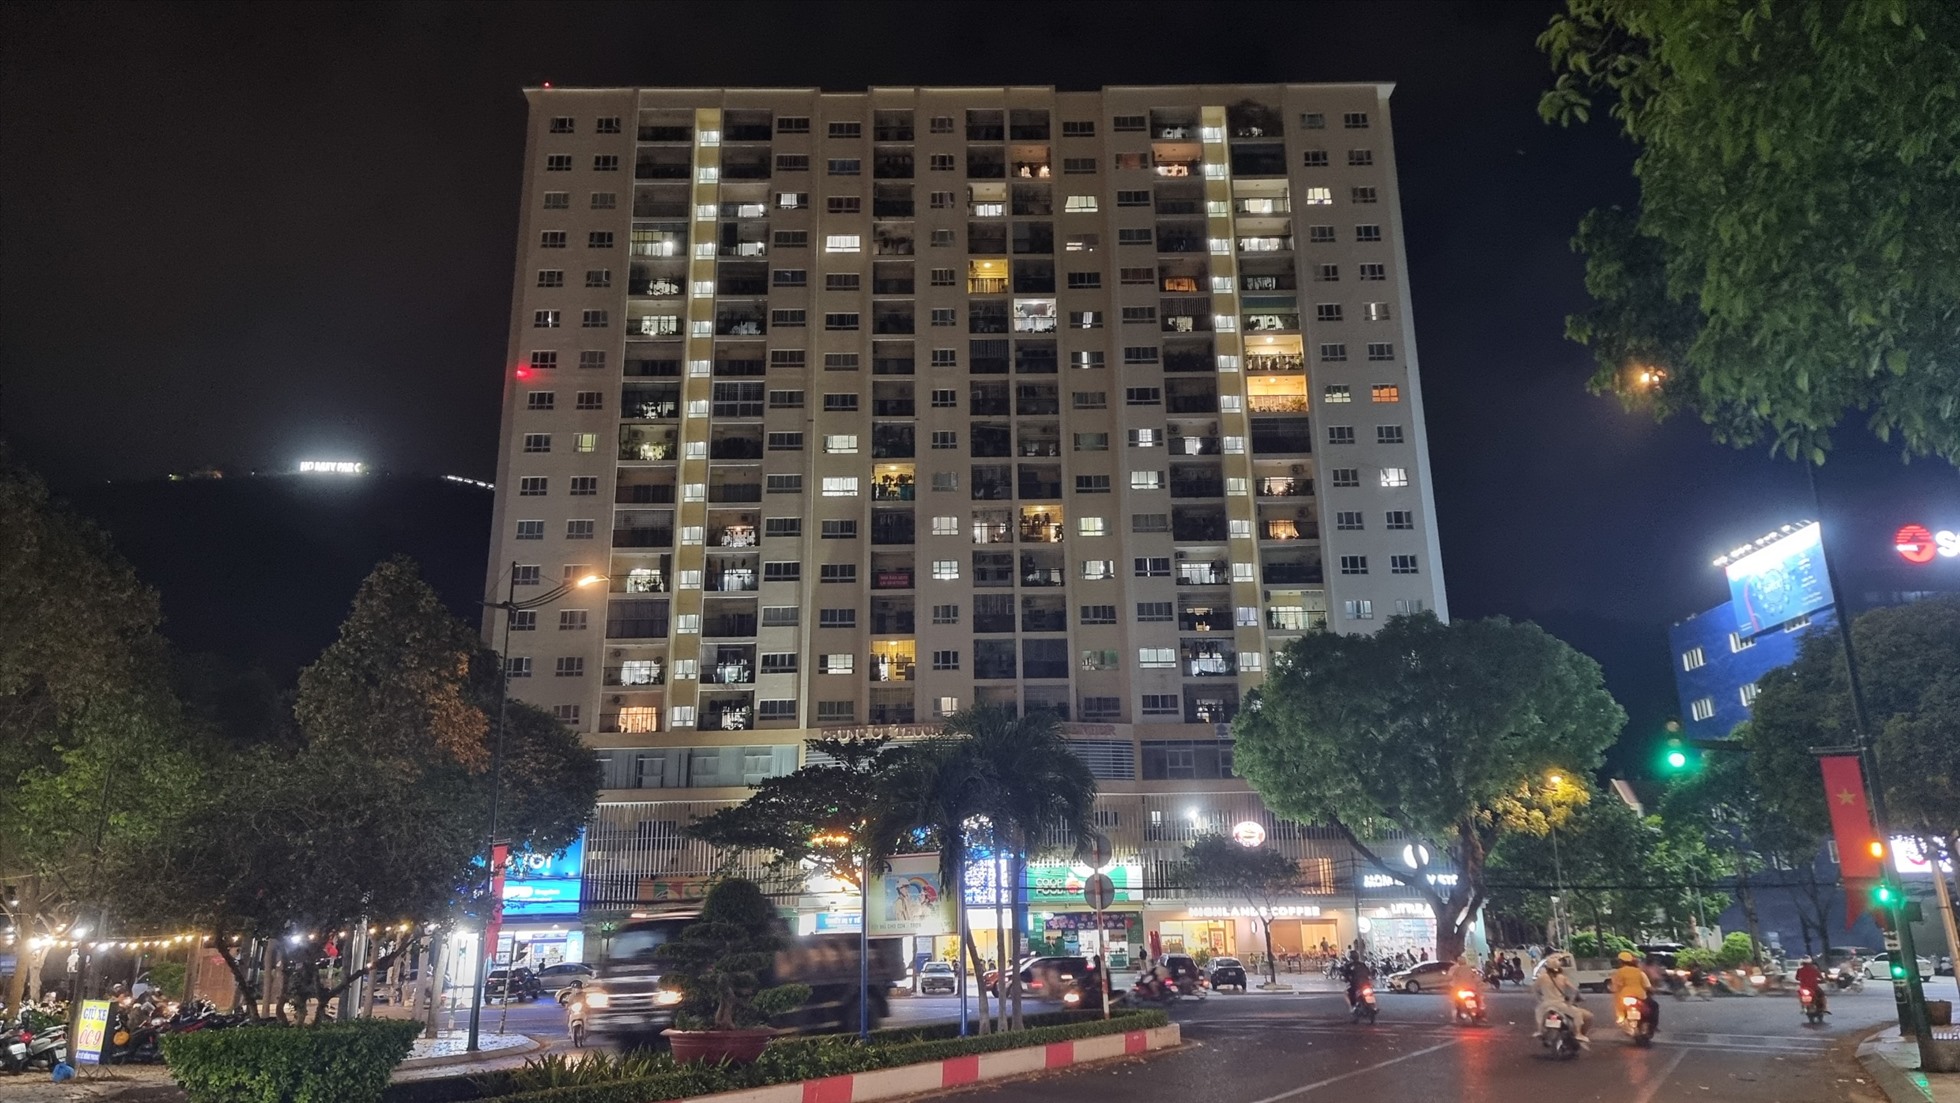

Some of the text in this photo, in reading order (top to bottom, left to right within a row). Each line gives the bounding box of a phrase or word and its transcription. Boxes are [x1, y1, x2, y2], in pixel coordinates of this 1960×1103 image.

[1935, 530, 1960, 558] S
[1036, 878, 1063, 888] COOP
[1188, 906, 1320, 917] HIGHLANDS COFFEE
[97, 1009, 108, 1021] XE
